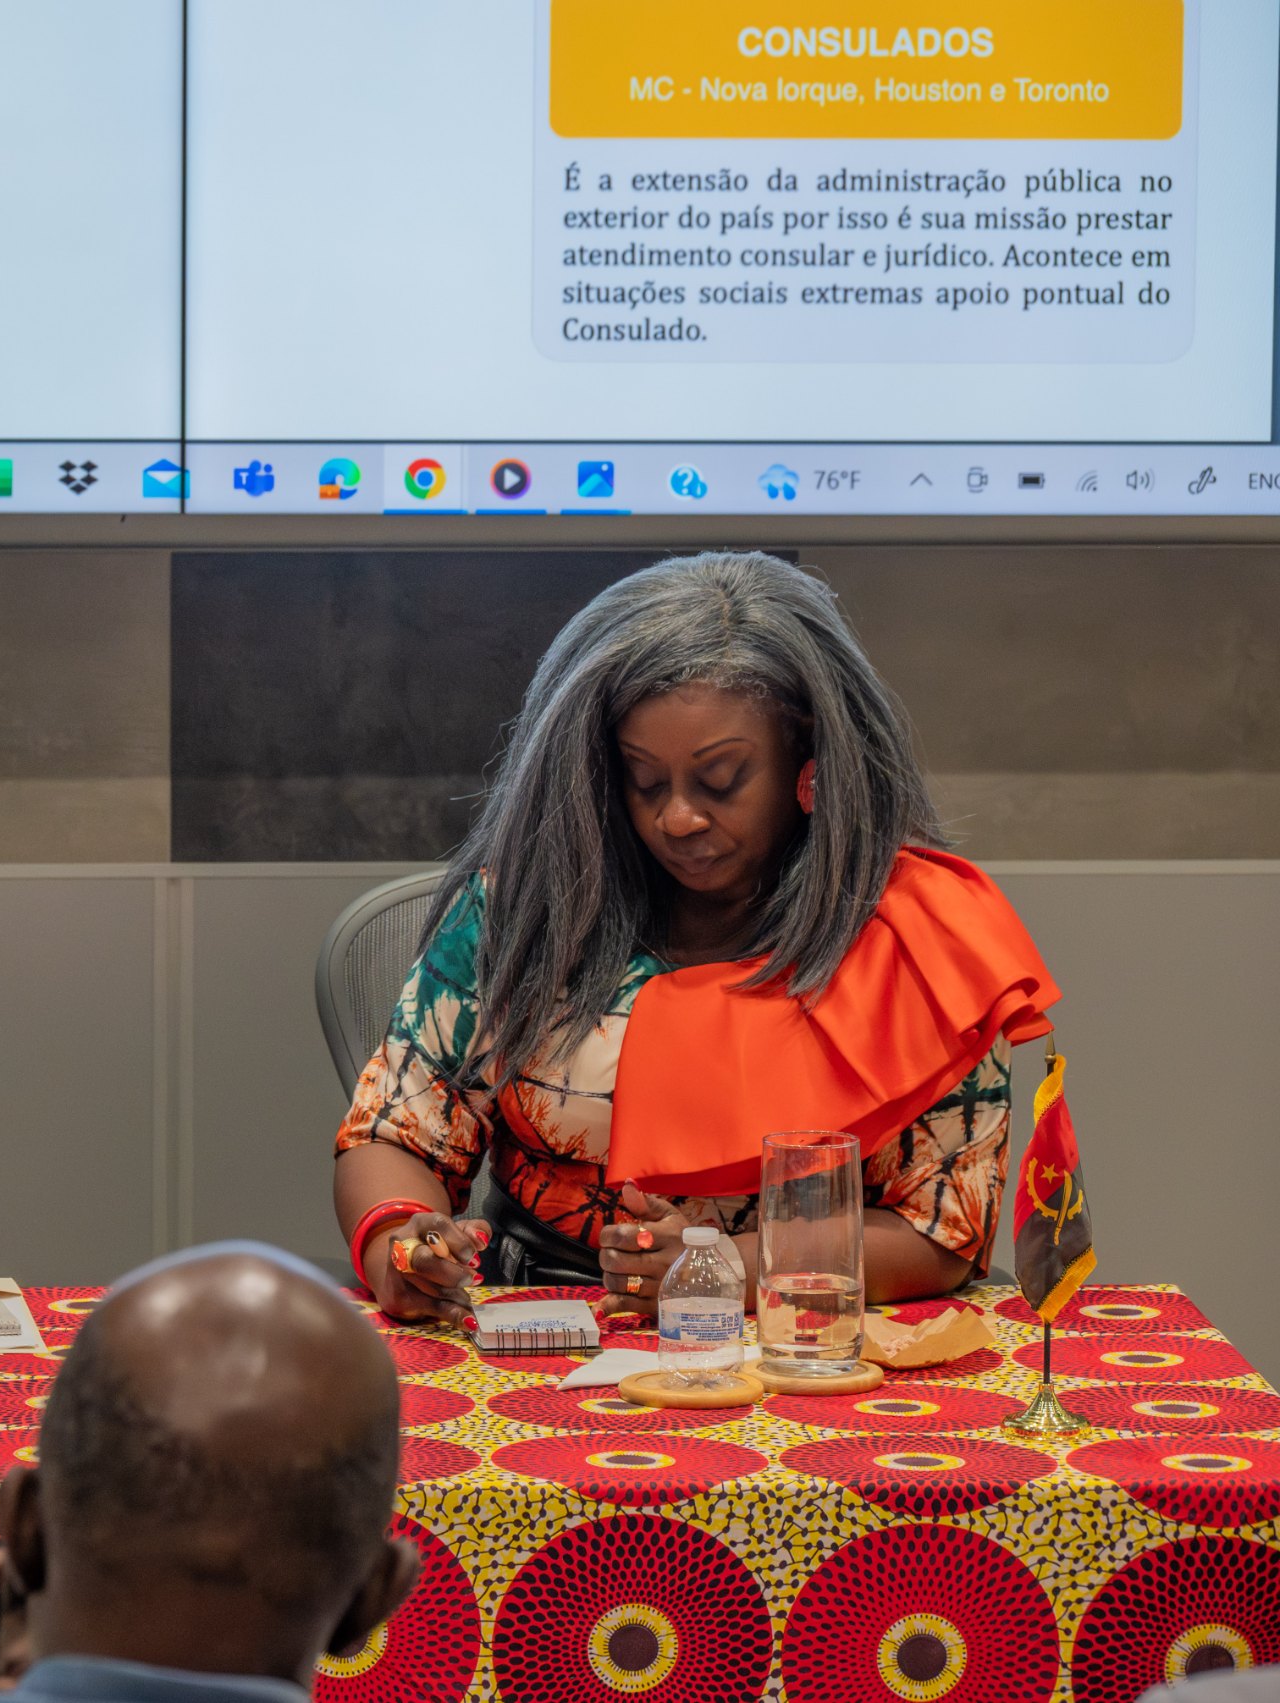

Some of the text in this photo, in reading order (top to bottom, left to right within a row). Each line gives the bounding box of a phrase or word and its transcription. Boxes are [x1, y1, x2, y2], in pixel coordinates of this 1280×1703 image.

[736, 25, 995, 59] CONSULADOS
[629, 75, 675, 102] MC
[699, 76, 769, 102] Nova
[776, 76, 865, 107] Iorque,
[874, 77, 982, 103] Houston
[989, 82, 1007, 103] e
[1012, 76, 1110, 103] Toronto
[564, 161, 1173, 199] É a extensão da administração pública no
[563, 204, 1173, 237] exterior do país por isso é sua missão prestar
[562, 242, 1171, 273] atendimento consular e jurídico. Acontece em
[562, 280, 1171, 312] situações sociais extremas apoio pontual do
[562, 316, 707, 342] Consulado.
[813, 469, 861, 491] 76°F
